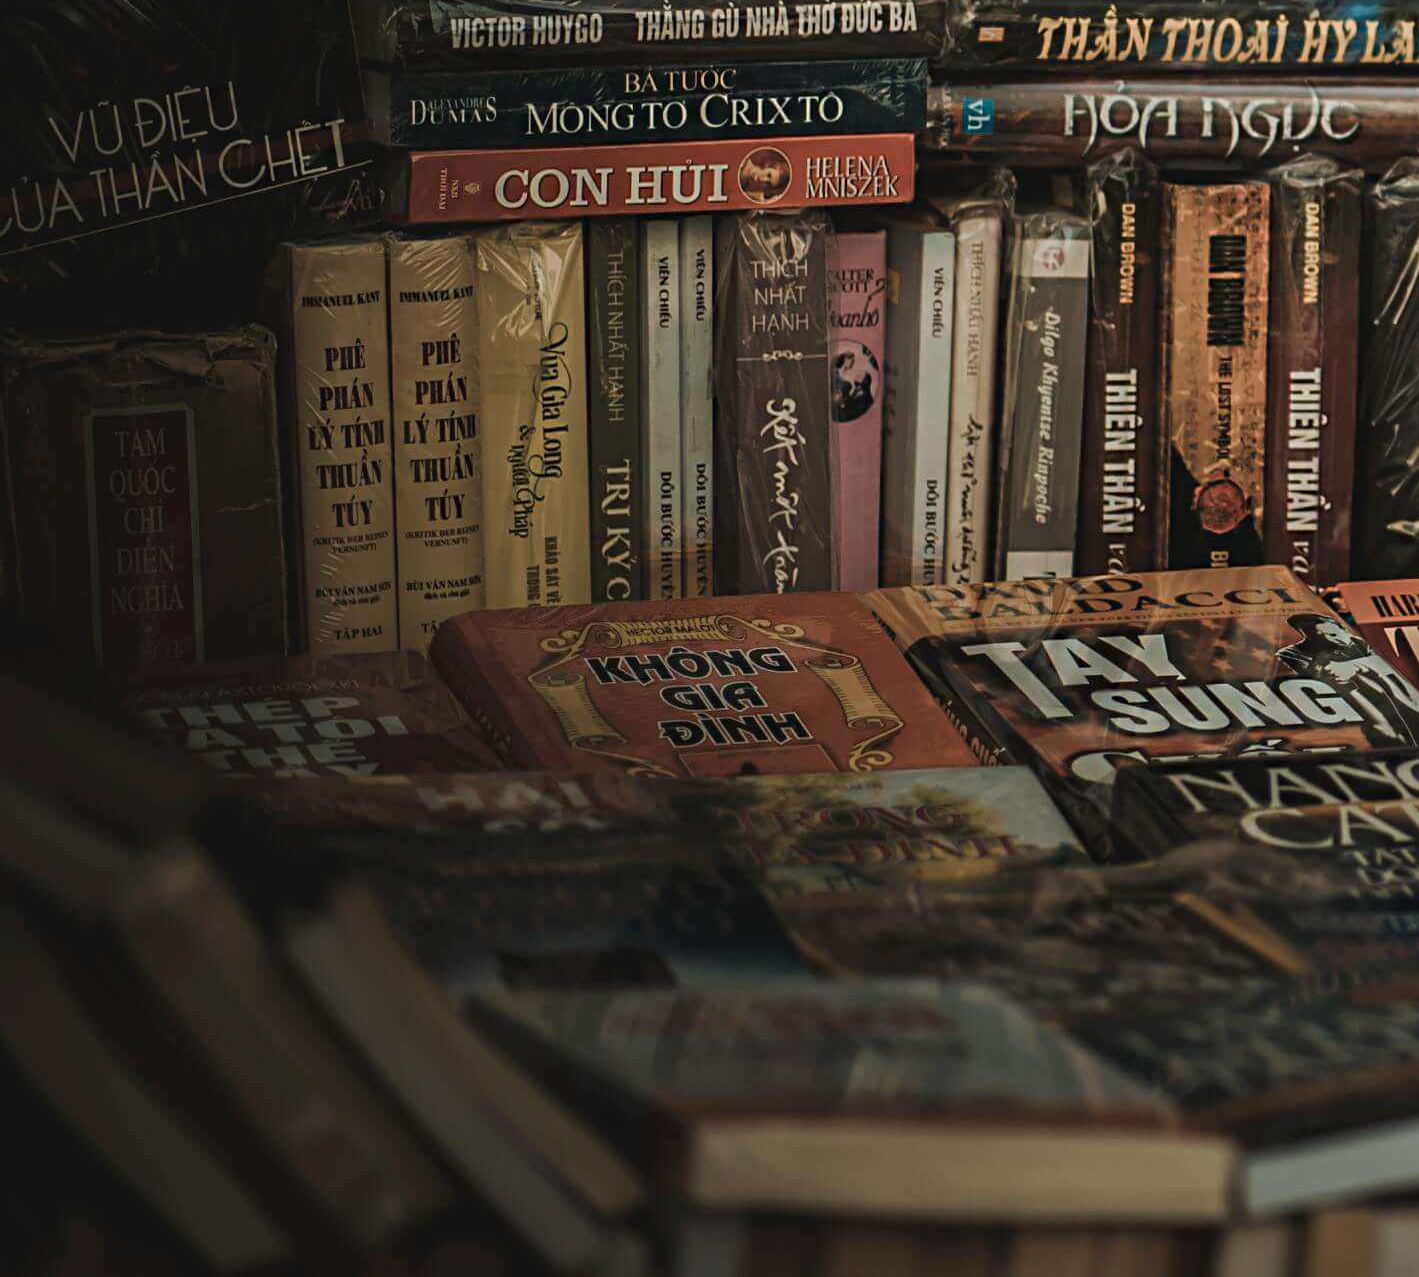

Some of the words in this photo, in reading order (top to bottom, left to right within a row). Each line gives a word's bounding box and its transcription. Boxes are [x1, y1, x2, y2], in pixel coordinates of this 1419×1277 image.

[449, 16, 526, 50] VICTOR
[531, 12, 604, 47] HUYGO
[710, 4, 741, 39] GÙ
[1036, 3, 1153, 62] THẦN
[48, 98, 124, 164] VŨ
[133, 80, 239, 149] ĐIỆU
[411, 96, 498, 126] DUMAS
[700, 92, 792, 130] CRIX
[494, 167, 614, 211] CON
[625, 158, 729, 205] HỦI
[806, 154, 890, 180] HELENA
[805, 176, 898, 200] MNISZEK
[1120, 202, 1137, 239] DAN
[1304, 202, 1321, 239] DAN
[750, 257, 809, 279] THÍCH
[1119, 241, 1137, 304] BROWN
[1302, 240, 1321, 304] BROWN
[754, 279, 807, 306] NHẤT
[751, 312, 810, 337] HẠNH
[1042, 309, 1062, 358] Dilgo
[323, 337, 367, 372] PHÊ
[421, 333, 462, 367] PHÊ
[1217, 355, 1233, 378] THE
[318, 376, 375, 412] PHÁN
[414, 371, 469, 406] PHÁN
[1038, 360, 1059, 442] Khyentse
[1217, 380, 1233, 412] LOST
[1103, 368, 1144, 453] THIÊN
[1287, 367, 1329, 451] THIÊN
[114, 428, 168, 460] TAM
[307, 411, 335, 451] LÝ
[340, 412, 386, 449] TÍNH
[402, 410, 431, 446] LÝ
[434, 410, 478, 444] TÍNH
[316, 447, 383, 490] THUẦN
[409, 442, 475, 484] THUẦN
[600, 458, 632, 517] TRI
[1035, 446, 1056, 525] Rinpoche
[1101, 458, 1147, 535] THẦN
[1286, 456, 1332, 532] THẦN
[331, 497, 373, 528] TÚY
[424, 489, 466, 523] TÚY
[625, 624, 677, 637] HECTOR
[678, 623, 717, 636] MALOT
[583, 645, 799, 686] KHÔNG
[961, 633, 1188, 720] TAY
[658, 680, 769, 713] GIA
[657, 712, 815, 749] ĐÌNH
